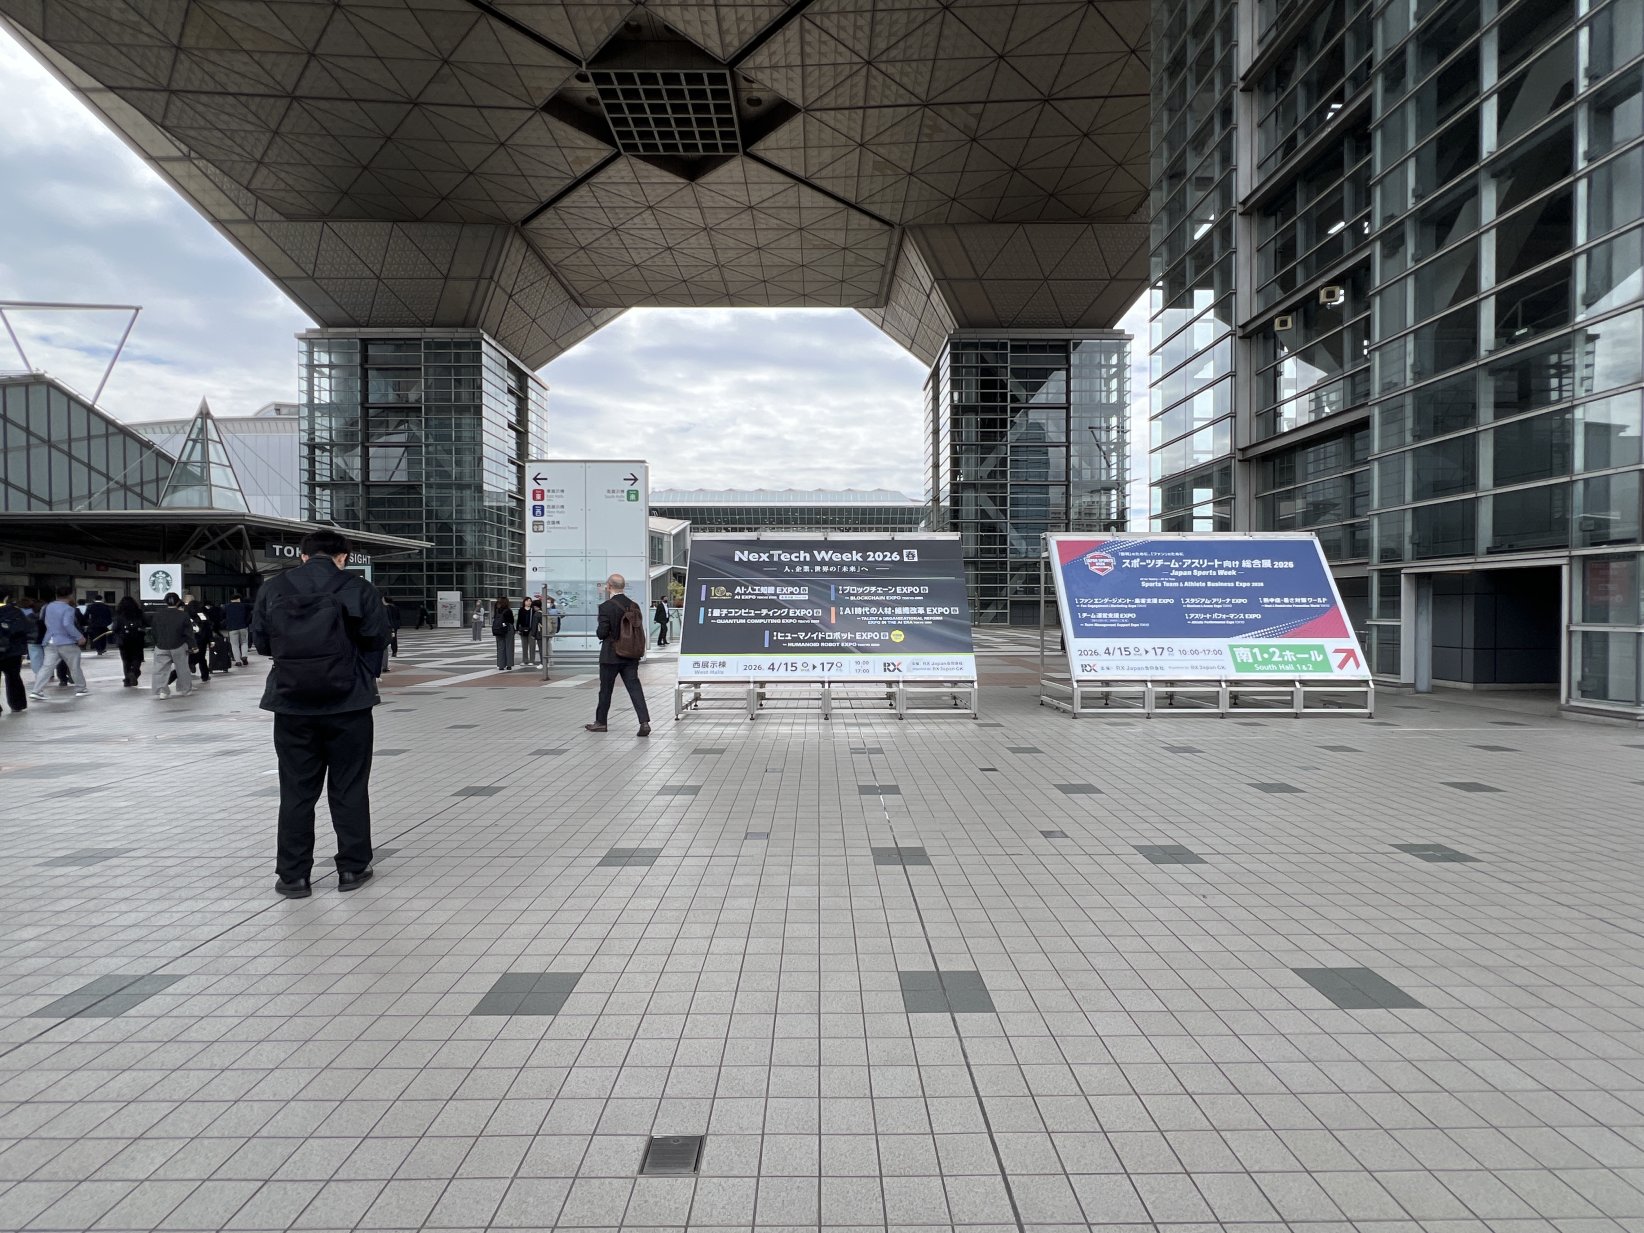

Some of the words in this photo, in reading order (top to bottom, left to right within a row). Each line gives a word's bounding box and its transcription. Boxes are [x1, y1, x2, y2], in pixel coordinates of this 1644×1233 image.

[349, 552, 371, 565] SIGHT
[734, 550, 810, 562] NexTech
[813, 550, 864, 562] Week
[866, 552, 900, 562] 2026
[1273, 561, 1294, 569] 2026
[776, 586, 799, 594] EXPO
[843, 586, 895, 594] ブロックチェーン
[896, 586, 919, 594] EXPO
[789, 609, 812, 617] EXPO
[926, 607, 950, 615] EXPO
[777, 632, 855, 640] ヒューマノイドロボット
[856, 632, 879, 640] EXPO
[1104, 646, 1131, 656] 4/15
[1152, 646, 1165, 656] 17
[1233, 646, 1324, 663] 南1・2ホール
[692, 661, 727, 669] 西展示棟
[768, 662, 798, 672] 4/15
[820, 662, 835, 672] 17
[883, 661, 903, 673] RX
[1080, 663, 1098, 673] RX
[1254, 663, 1277, 671] South
[1279, 663, 1294, 671] Hall
